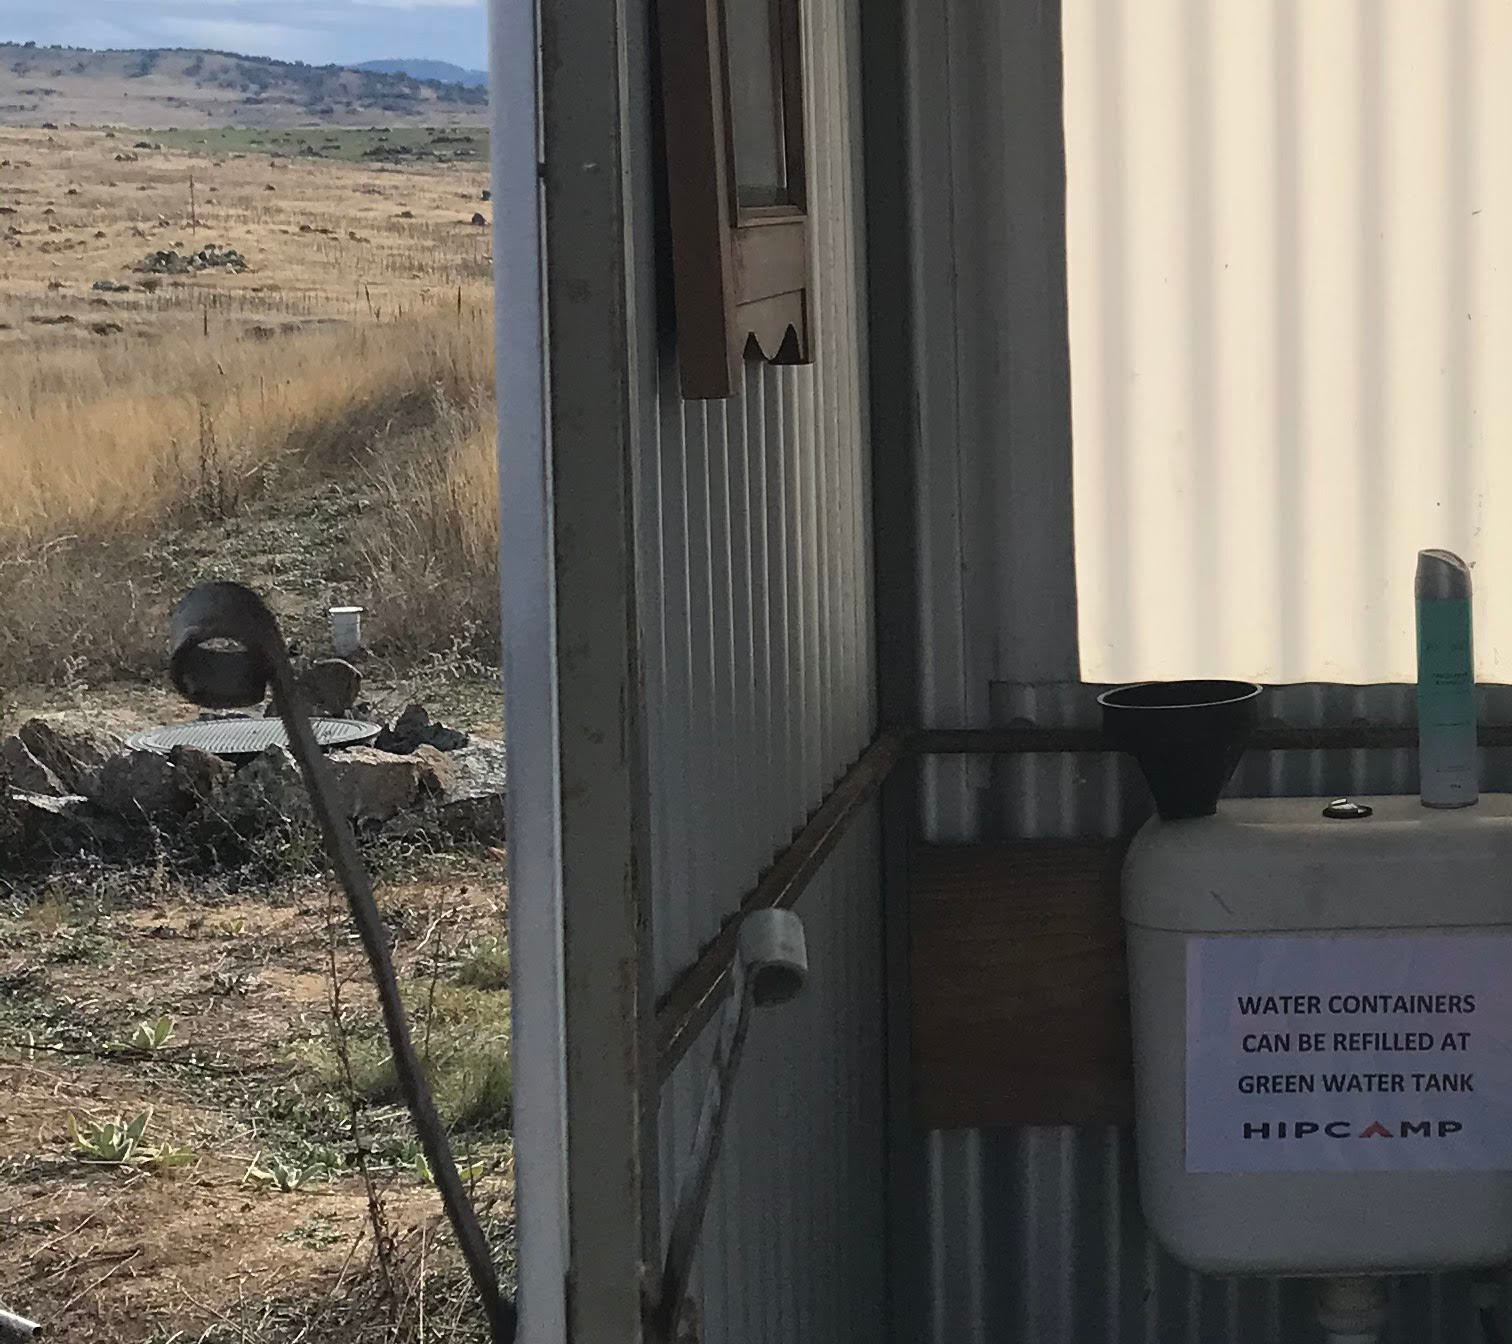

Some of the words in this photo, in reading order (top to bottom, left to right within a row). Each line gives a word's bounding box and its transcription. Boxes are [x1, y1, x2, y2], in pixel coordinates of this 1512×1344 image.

[1238, 995, 1321, 1016] WATER
[1328, 994, 1476, 1015] CONTAINERS
[1242, 1033, 1291, 1053] CAN
[1299, 1033, 1326, 1052] BE
[1333, 1032, 1434, 1052] REFILLED
[1440, 1032, 1471, 1051] AT
[1238, 1074, 1315, 1094] GREEN
[1321, 1073, 1404, 1093] WATER
[1411, 1072, 1474, 1092] TANK
[1243, 1120, 1463, 1139] HIPCAMP
